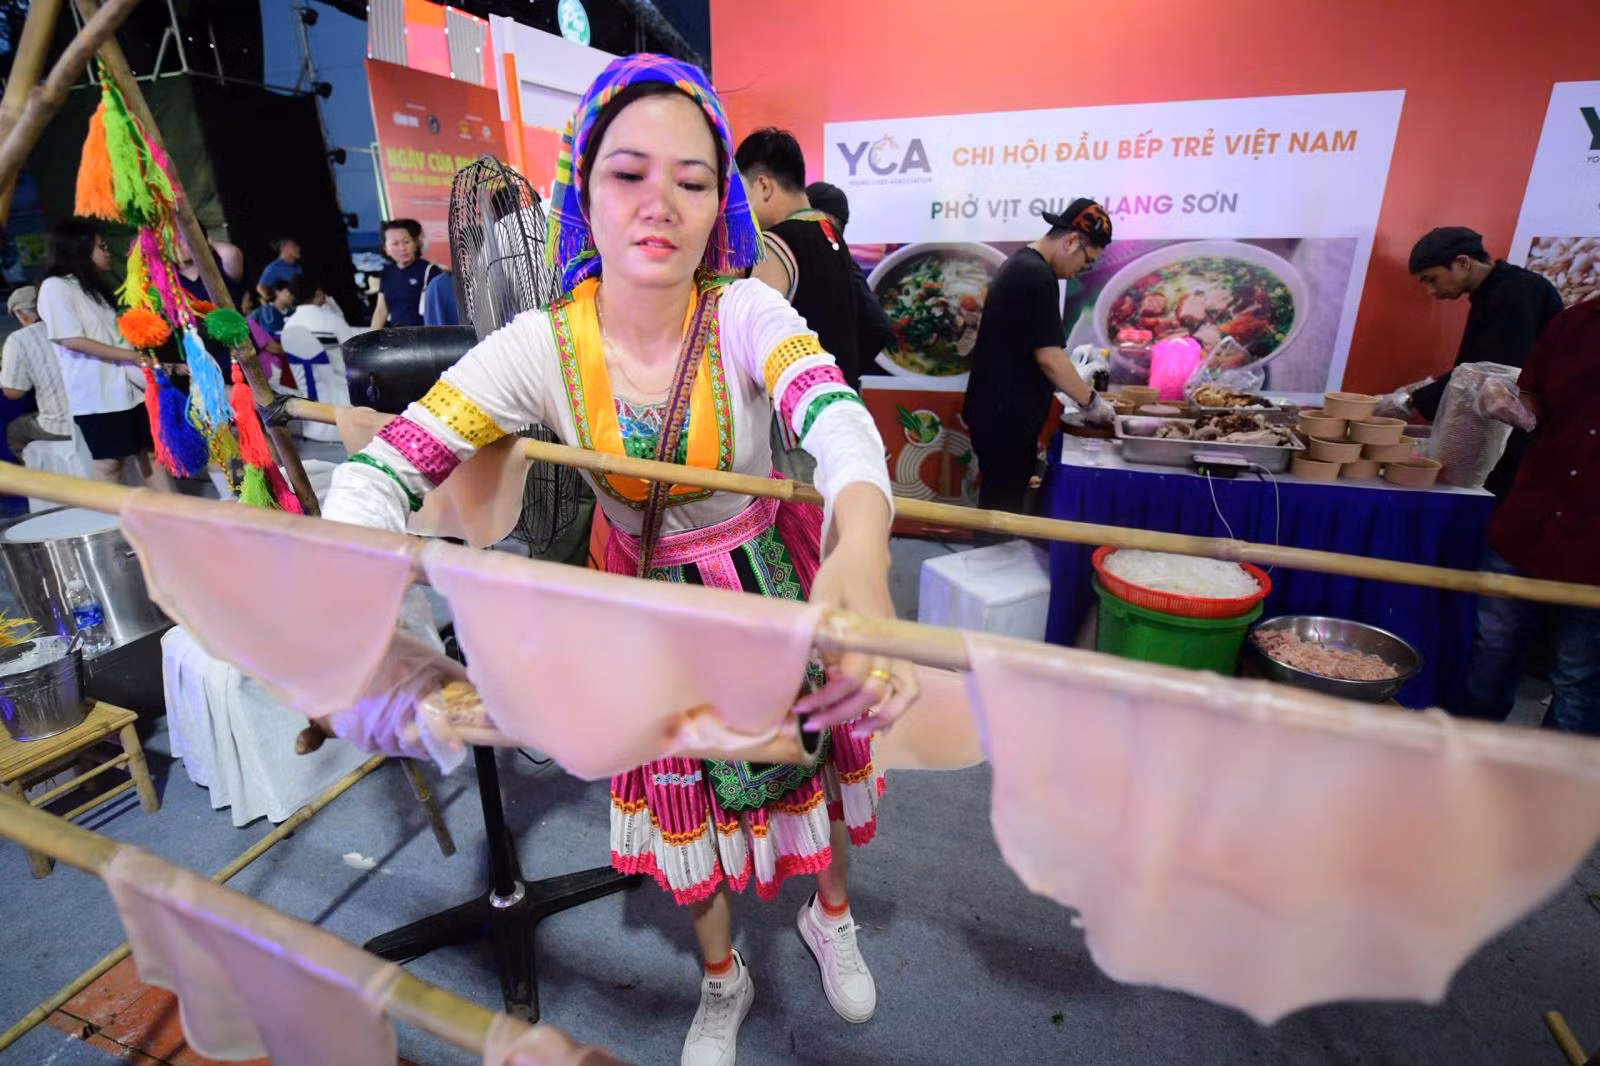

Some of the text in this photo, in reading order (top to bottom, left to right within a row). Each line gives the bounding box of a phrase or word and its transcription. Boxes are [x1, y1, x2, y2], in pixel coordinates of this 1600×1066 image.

[836, 137, 932, 176] YCA
[952, 128, 1358, 169] CHI HỘI ĐẦU BẾP TRẺ VIỆT NAM
[931, 190, 1238, 223] PHỞ VỊT QU LẠNG SƠN
